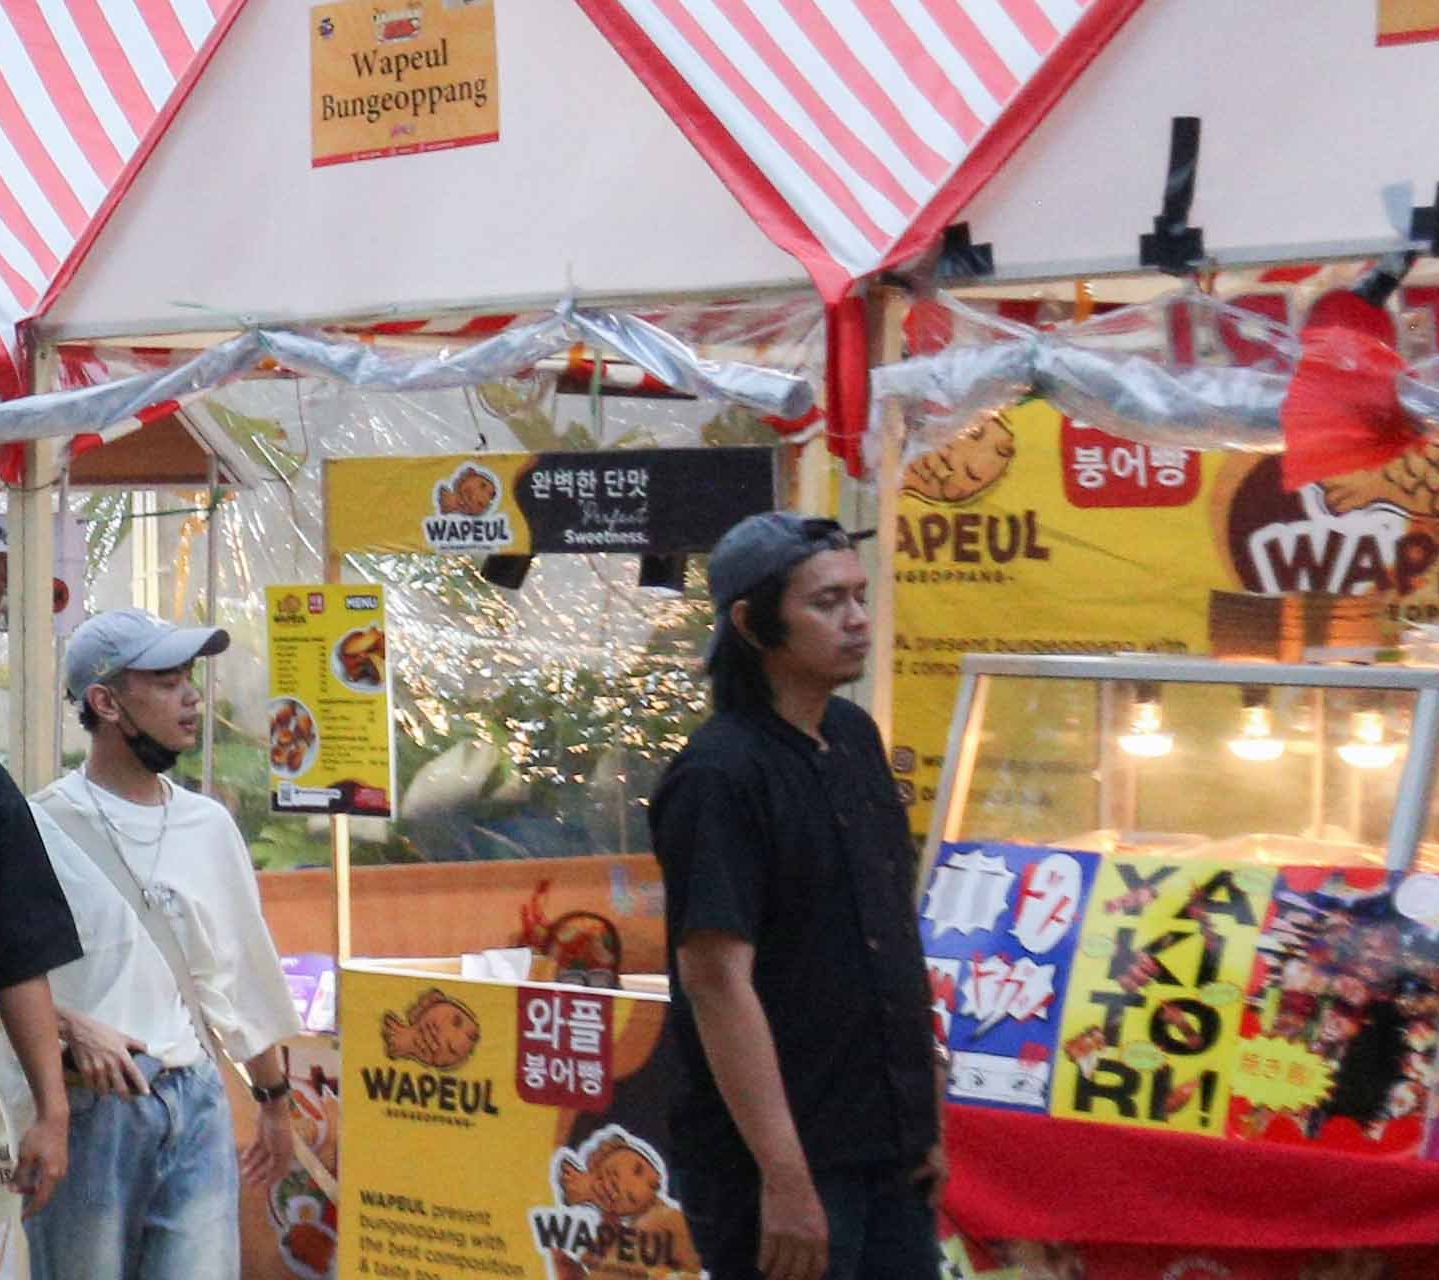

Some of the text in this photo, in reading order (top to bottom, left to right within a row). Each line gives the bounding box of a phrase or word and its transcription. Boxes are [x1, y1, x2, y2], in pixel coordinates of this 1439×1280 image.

[351, 38, 449, 82] Wapeul
[322, 77, 488, 124] Bungeoppang
[532, 468, 651, 499] 완벽한 단맛
[426, 519, 509, 543] WAPEUL
[896, 510, 1050, 564] APEUL
[524, 996, 607, 1055] 와플
[361, 1066, 499, 1117] WAPEUL
[522, 1052, 605, 1097] 붕어빵
[360, 1190, 491, 1226] WAPEUL present
[360, 1213, 508, 1252] bungeoppang with
[534, 1213, 682, 1269] WAPEUL
[388, 1239, 422, 1261] best
[425, 1249, 527, 1278] composition
